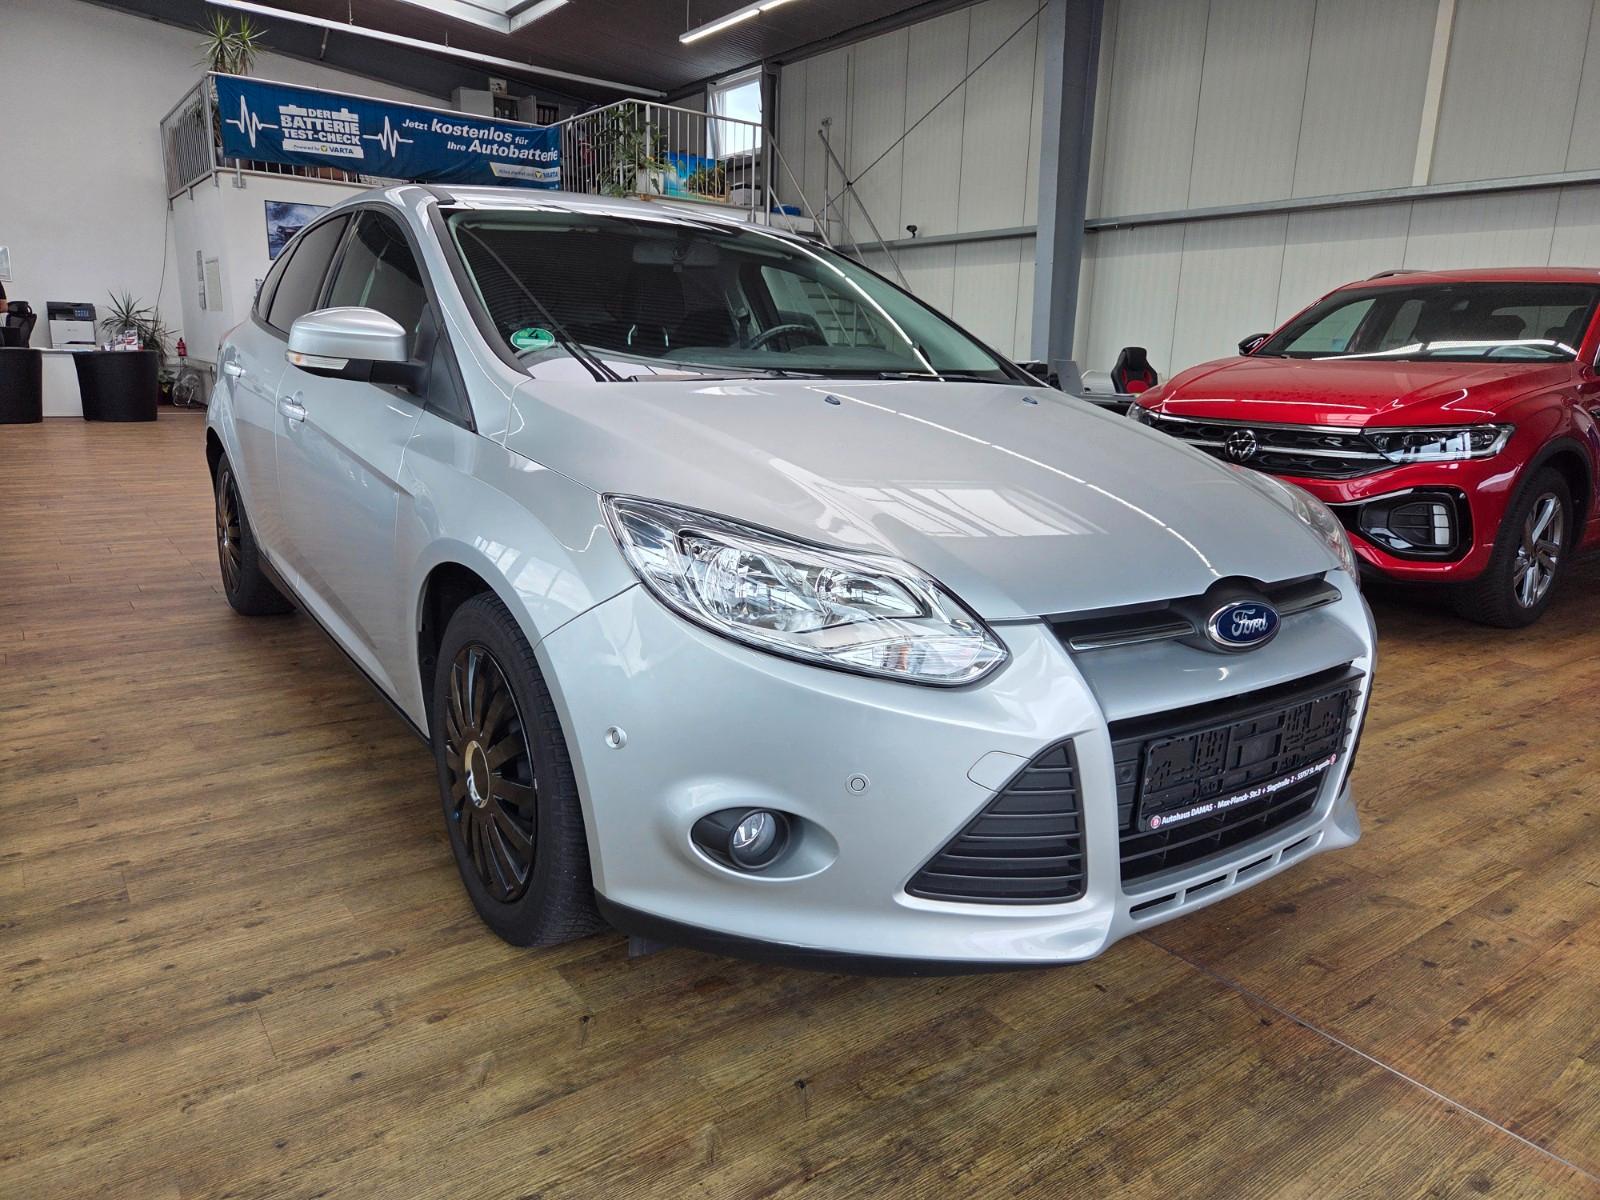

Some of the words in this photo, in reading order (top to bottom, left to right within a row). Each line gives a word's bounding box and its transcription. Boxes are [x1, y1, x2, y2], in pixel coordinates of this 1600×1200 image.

[308, 108, 332, 119] DER
[280, 114, 360, 135] BATTERIE
[401, 118, 428, 131] Jetzt
[431, 118, 512, 143] kostenlos
[515, 136, 529, 145] für
[282, 128, 361, 145] TEST-CHECK
[328, 146, 354, 155] VARTA
[447, 141, 466, 152] Ihre
[468, 139, 558, 162] Autobatterie
[527, 329, 539, 339] 4
[1231, 608, 1269, 637] Ford
[1161, 811, 1191, 825] Autohaus
[1190, 803, 1214, 817] DAMAS
